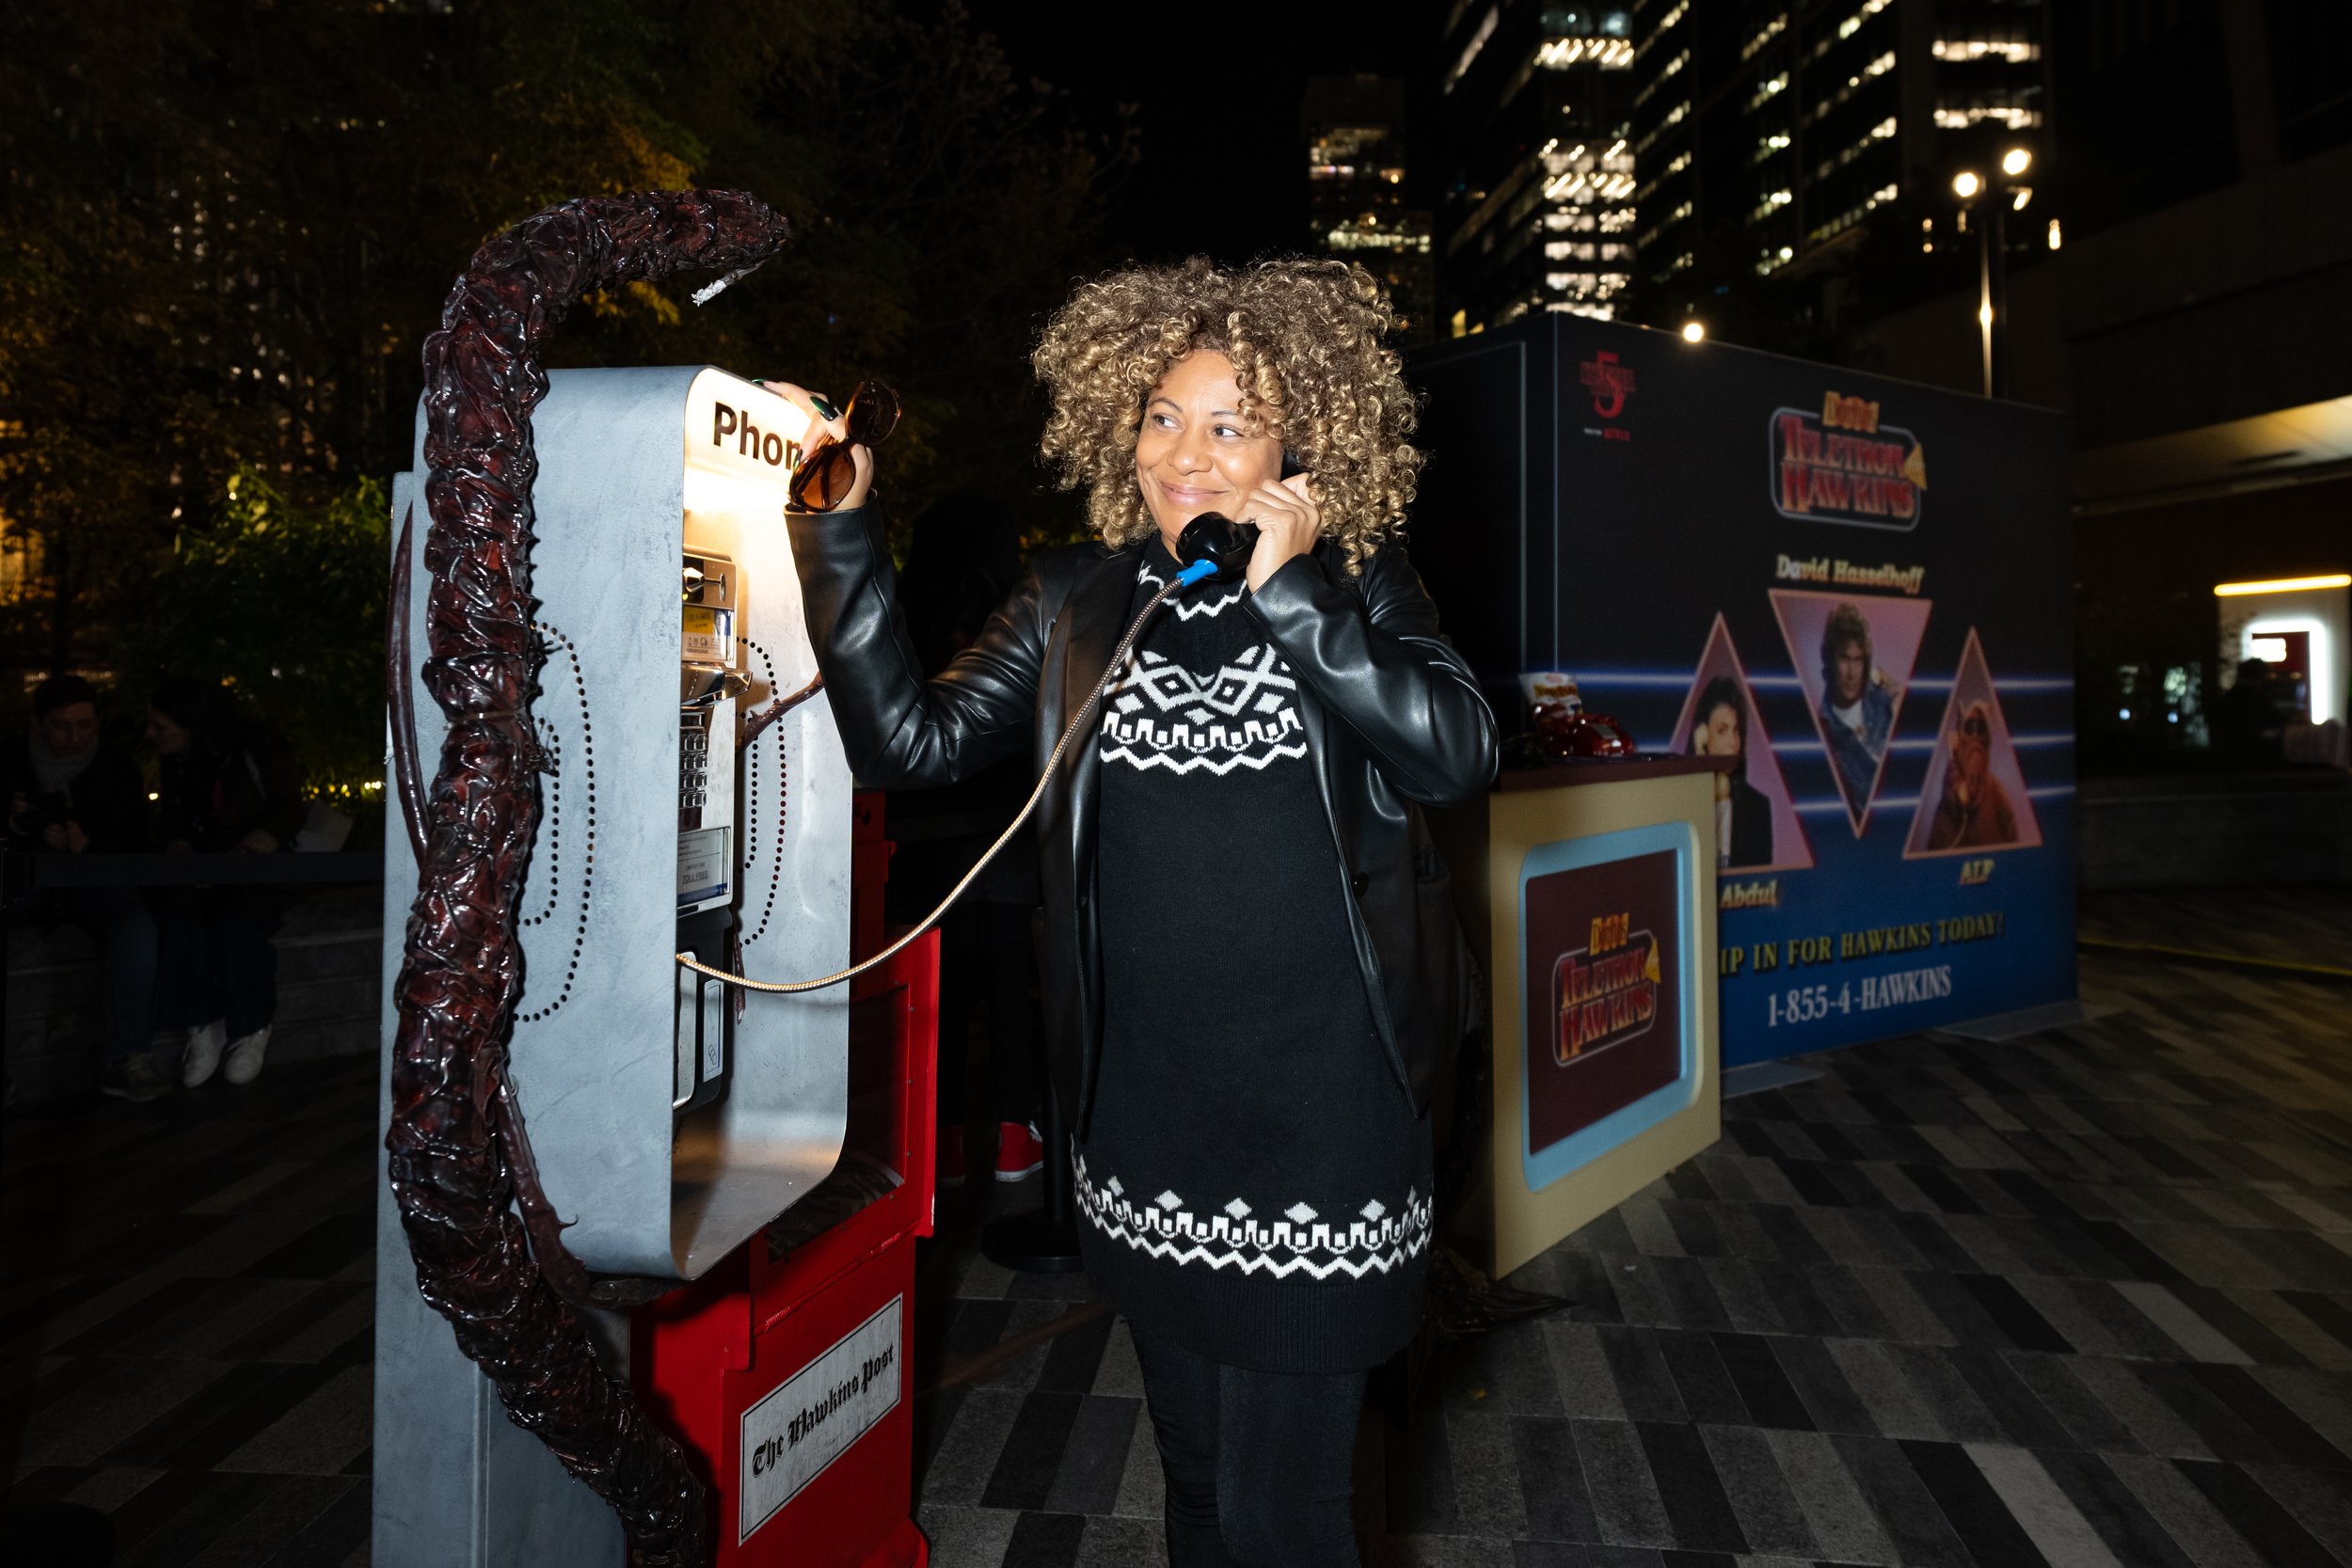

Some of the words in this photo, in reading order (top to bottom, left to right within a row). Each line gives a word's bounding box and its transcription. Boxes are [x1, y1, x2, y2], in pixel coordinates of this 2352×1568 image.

[1778, 415, 1905, 478] TELETHON
[1781, 463, 1915, 519] HAWKINS
[1775, 554, 1830, 583] David
[1833, 560, 1925, 595] Hasselhoff
[696, 871, 708, 881] FREE
[1719, 880, 1778, 909] Abdul
[1753, 942, 1778, 971] IN
[1788, 936, 1832, 967] FOR
[1841, 923, 1931, 959] HAWKINS
[1938, 912, 2003, 943] TODAY!
[1559, 948, 1645, 1008] TELETHON
[1559, 981, 1653, 1061] HAWKINS
[752, 1433, 785, 1479] The
[787, 1374, 860, 1452] Hawkins
[861, 1340, 894, 1393] Post
